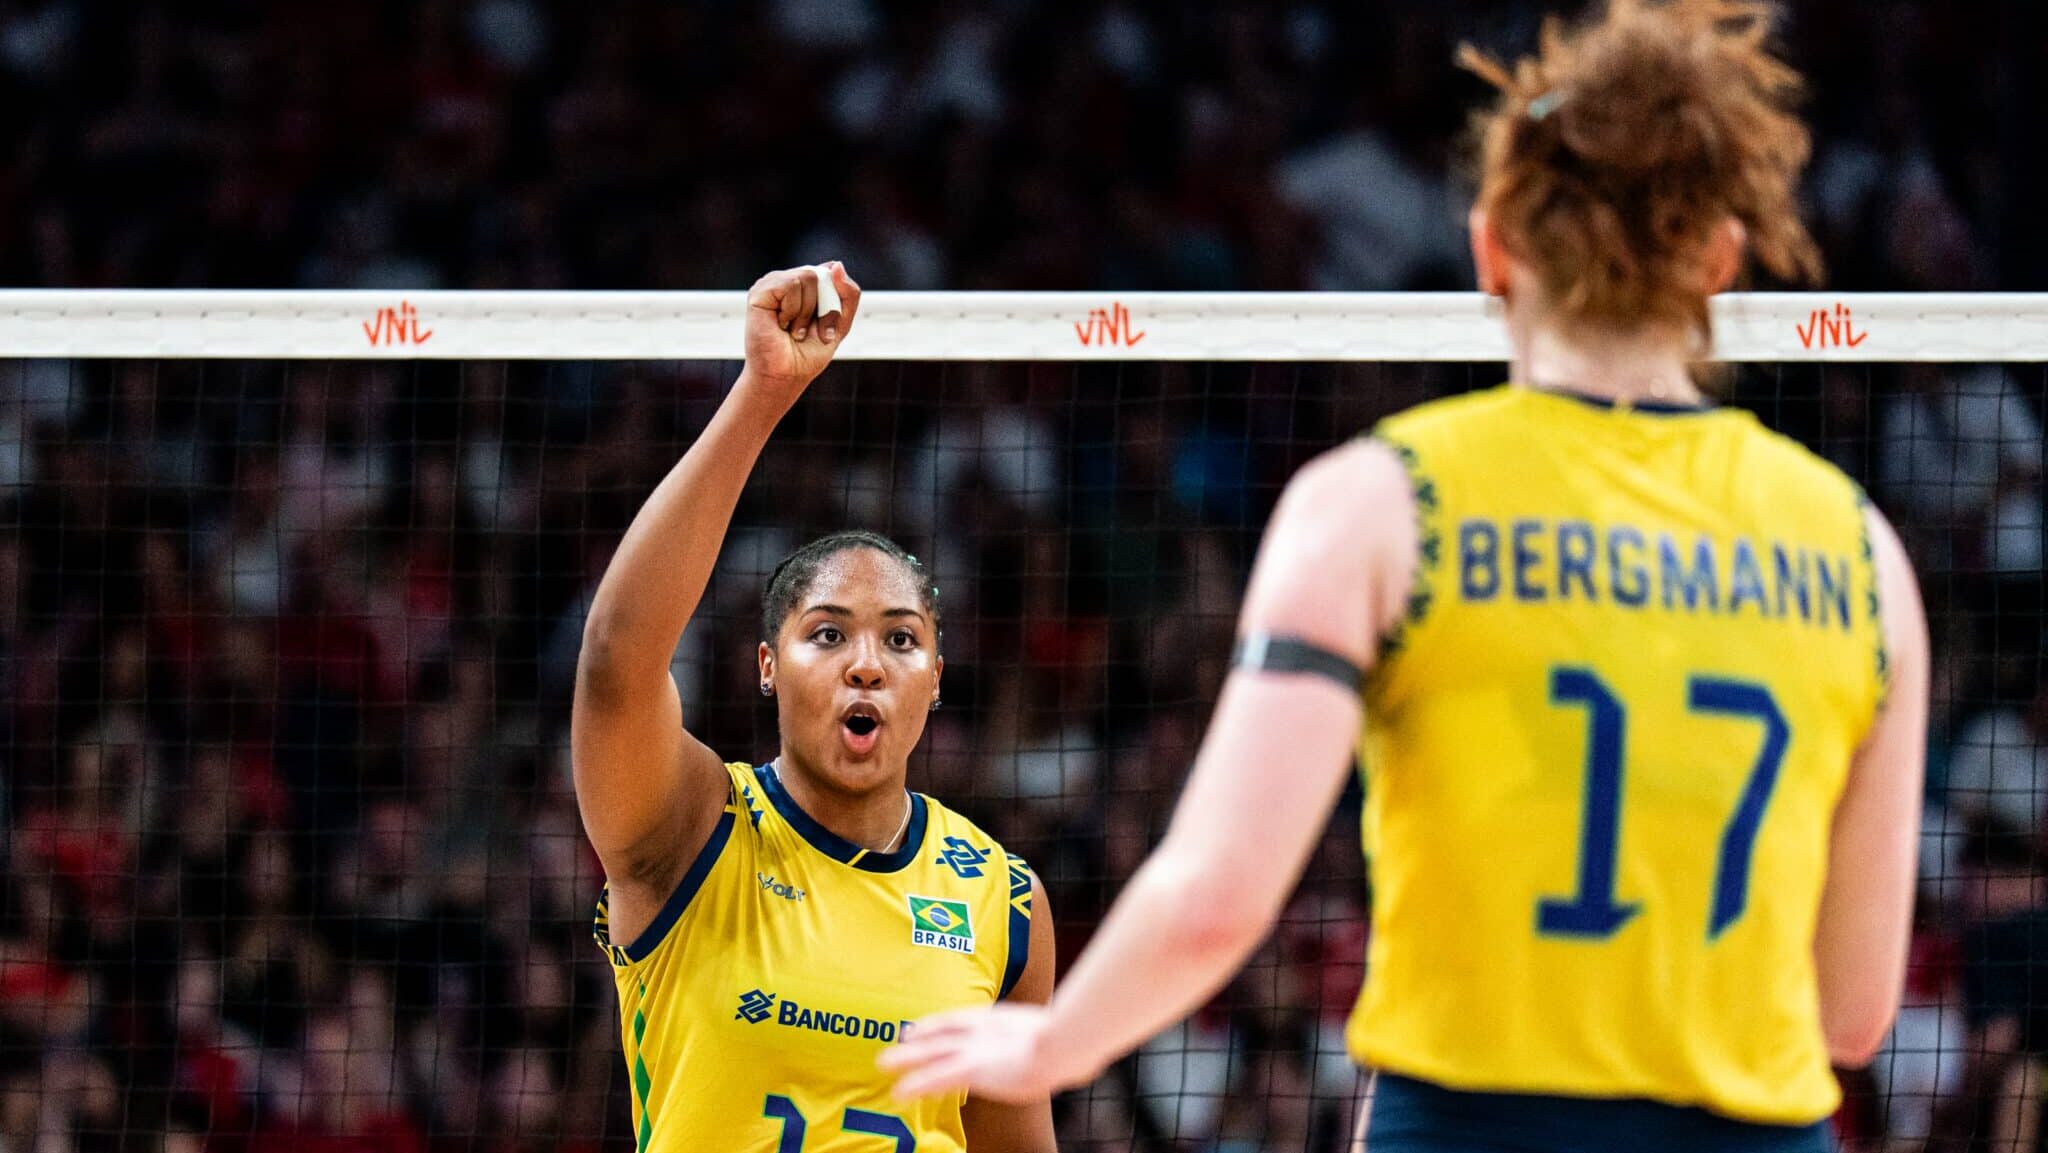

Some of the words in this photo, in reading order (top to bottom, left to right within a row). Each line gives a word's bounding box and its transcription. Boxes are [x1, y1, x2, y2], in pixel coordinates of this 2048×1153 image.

[362, 301, 432, 347] VNL
[1074, 301, 1145, 347] VNL
[1796, 302, 1867, 348] VNL
[1459, 519, 1852, 632] BERGMANN
[1535, 666, 1791, 942] 17
[914, 931, 972, 952] BRASIL
[778, 1000, 860, 1037] BANCO
[863, 1019, 895, 1043] DO
